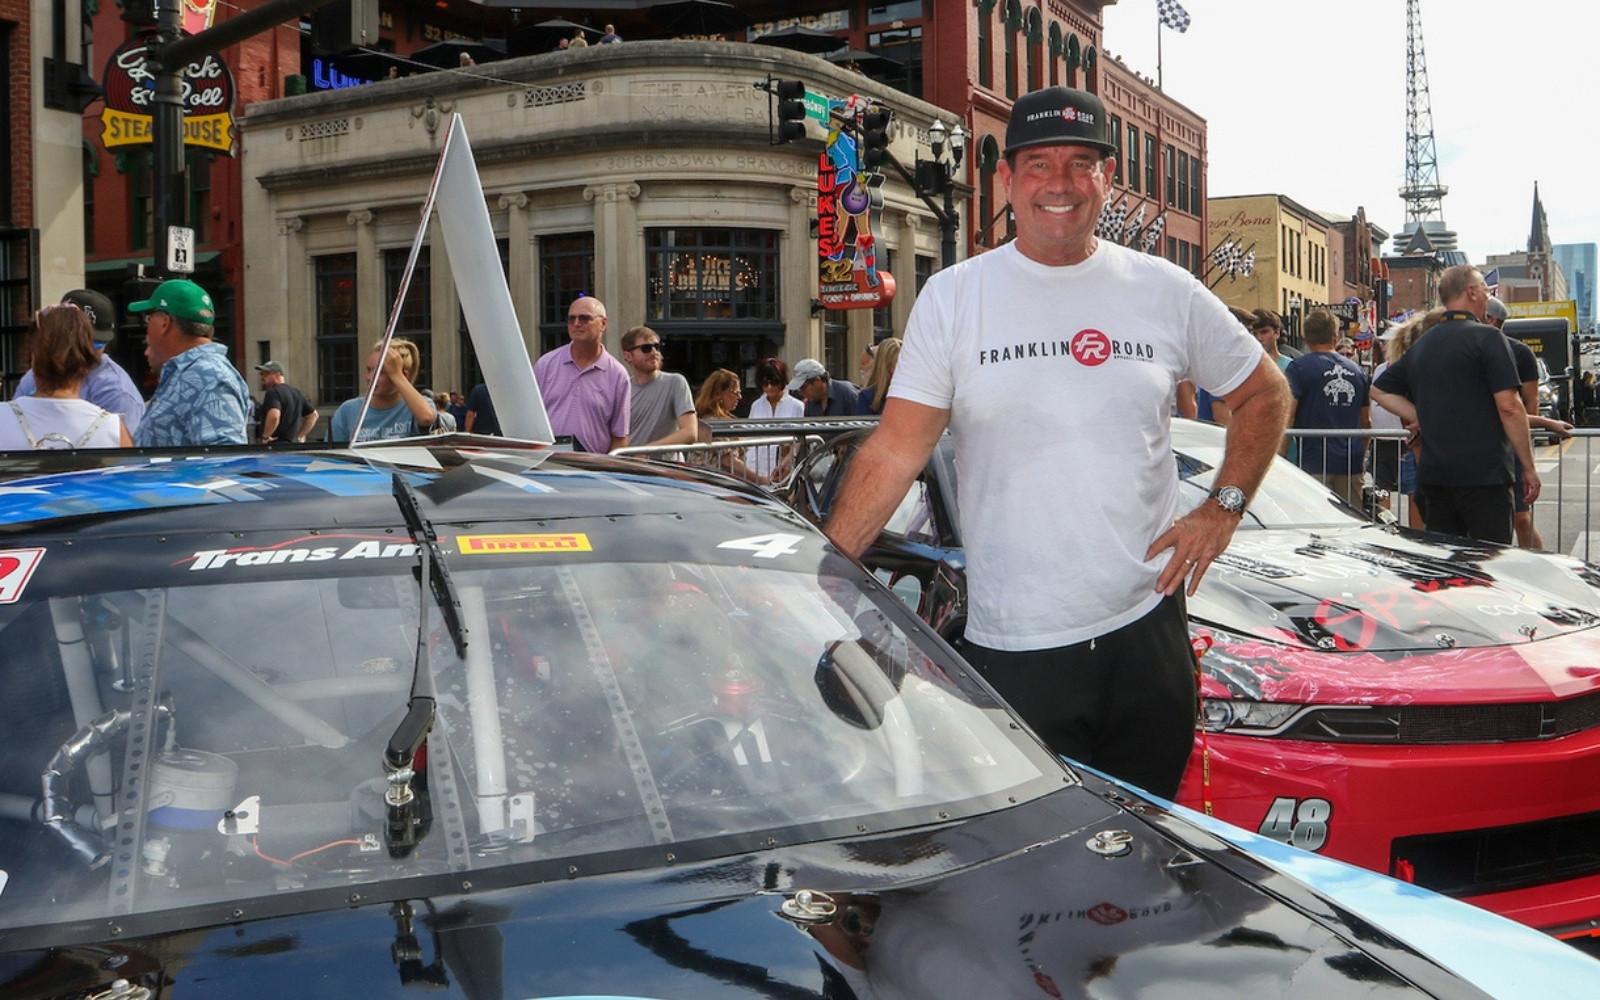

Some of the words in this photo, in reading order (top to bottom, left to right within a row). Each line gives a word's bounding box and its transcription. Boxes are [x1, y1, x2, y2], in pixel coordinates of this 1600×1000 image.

[643, 83, 682, 98] THE
[641, 104, 733, 123] NATIONAL
[1026, 110, 1061, 122] FRANKLIN
[110, 116, 222, 145] STEAOUSE
[634, 155, 726, 169] BROADWAY
[736, 156, 796, 173] BRANCH
[1231, 210, 1273, 226] Bona
[820, 258, 853, 283] 32
[980, 340, 1070, 366] FRANKLIN
[1112, 339, 1154, 359] ROAD
[469, 536, 579, 551] PIRELLI
[716, 533, 806, 558] 4
[189, 546, 341, 571] Trans
[1257, 796, 1332, 852] 48
